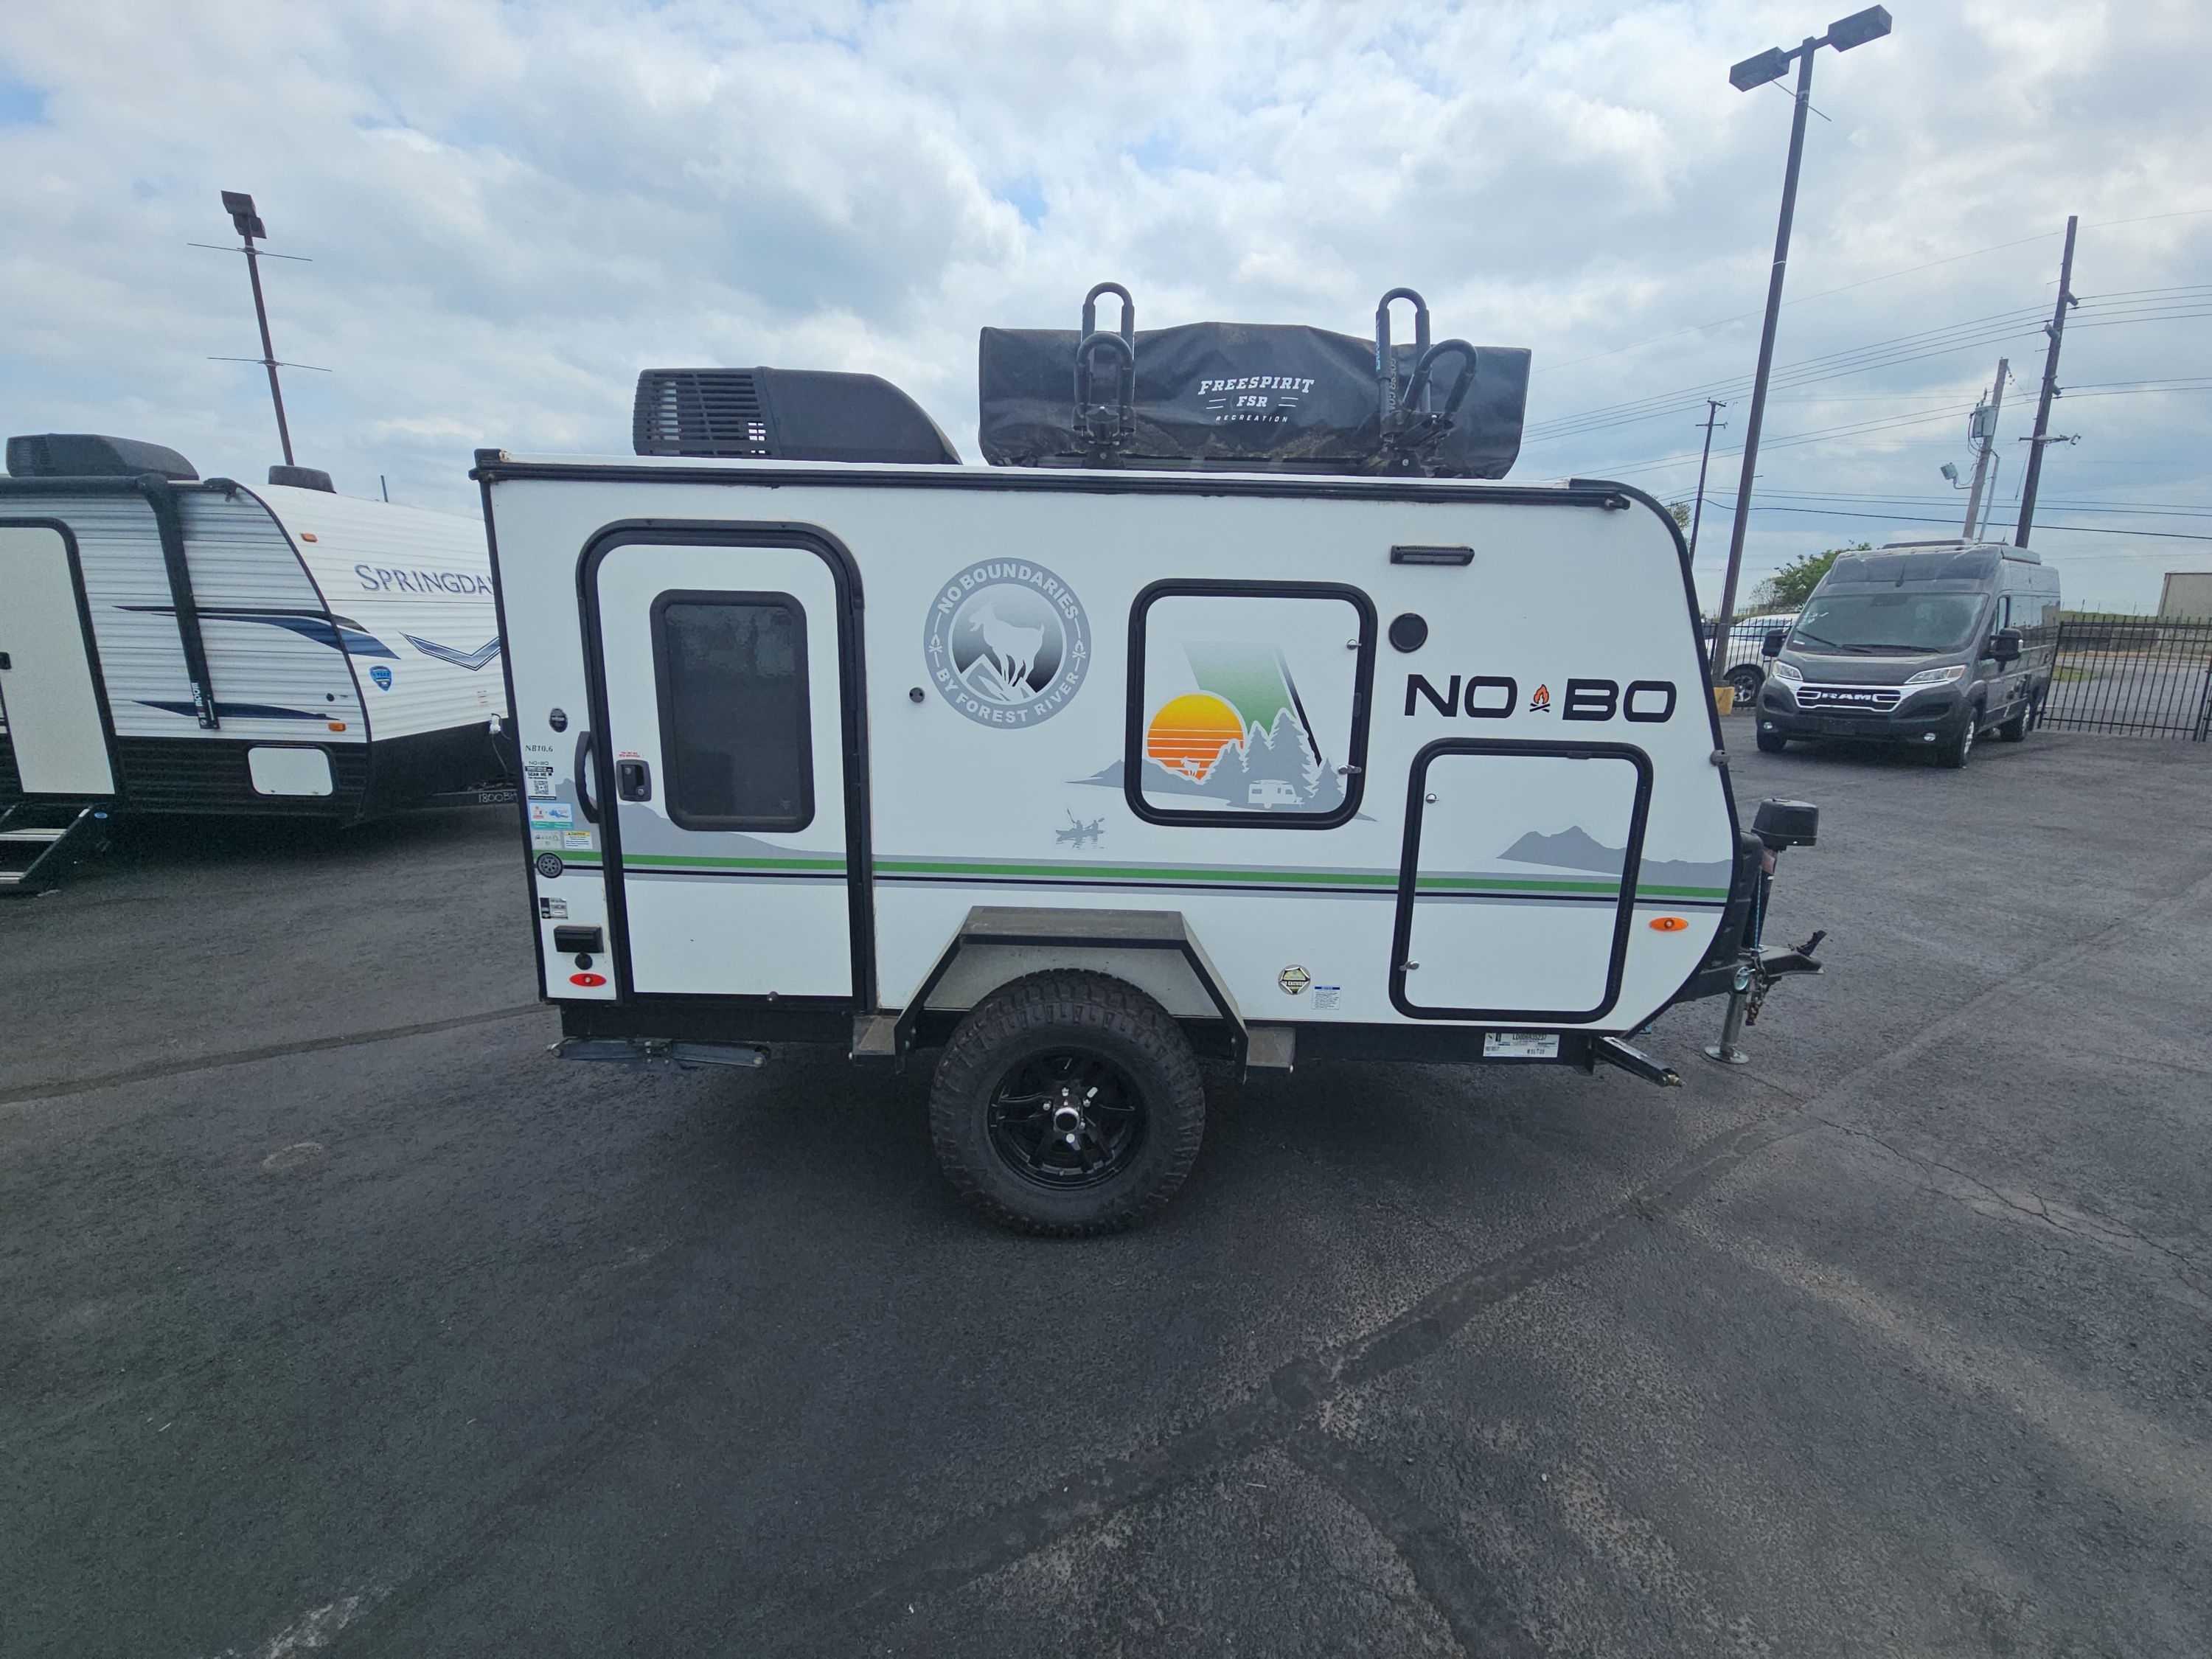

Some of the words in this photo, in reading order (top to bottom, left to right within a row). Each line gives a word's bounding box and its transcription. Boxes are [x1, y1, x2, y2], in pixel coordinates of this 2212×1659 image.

[1197, 376, 1314, 395] FREESPIRIT
[1237, 396, 1267, 407] FSR
[1216, 414, 1288, 422] RECREATION
[938, 586, 961, 614] NO
[959, 563, 1079, 619] BOUNDARIES
[936, 668, 959, 692] BY
[956, 692, 1028, 723] FOREST
[1034, 672, 1079, 715] RIVER
[1405, 674, 1517, 718] NO
[1562, 678, 1677, 723] BO
